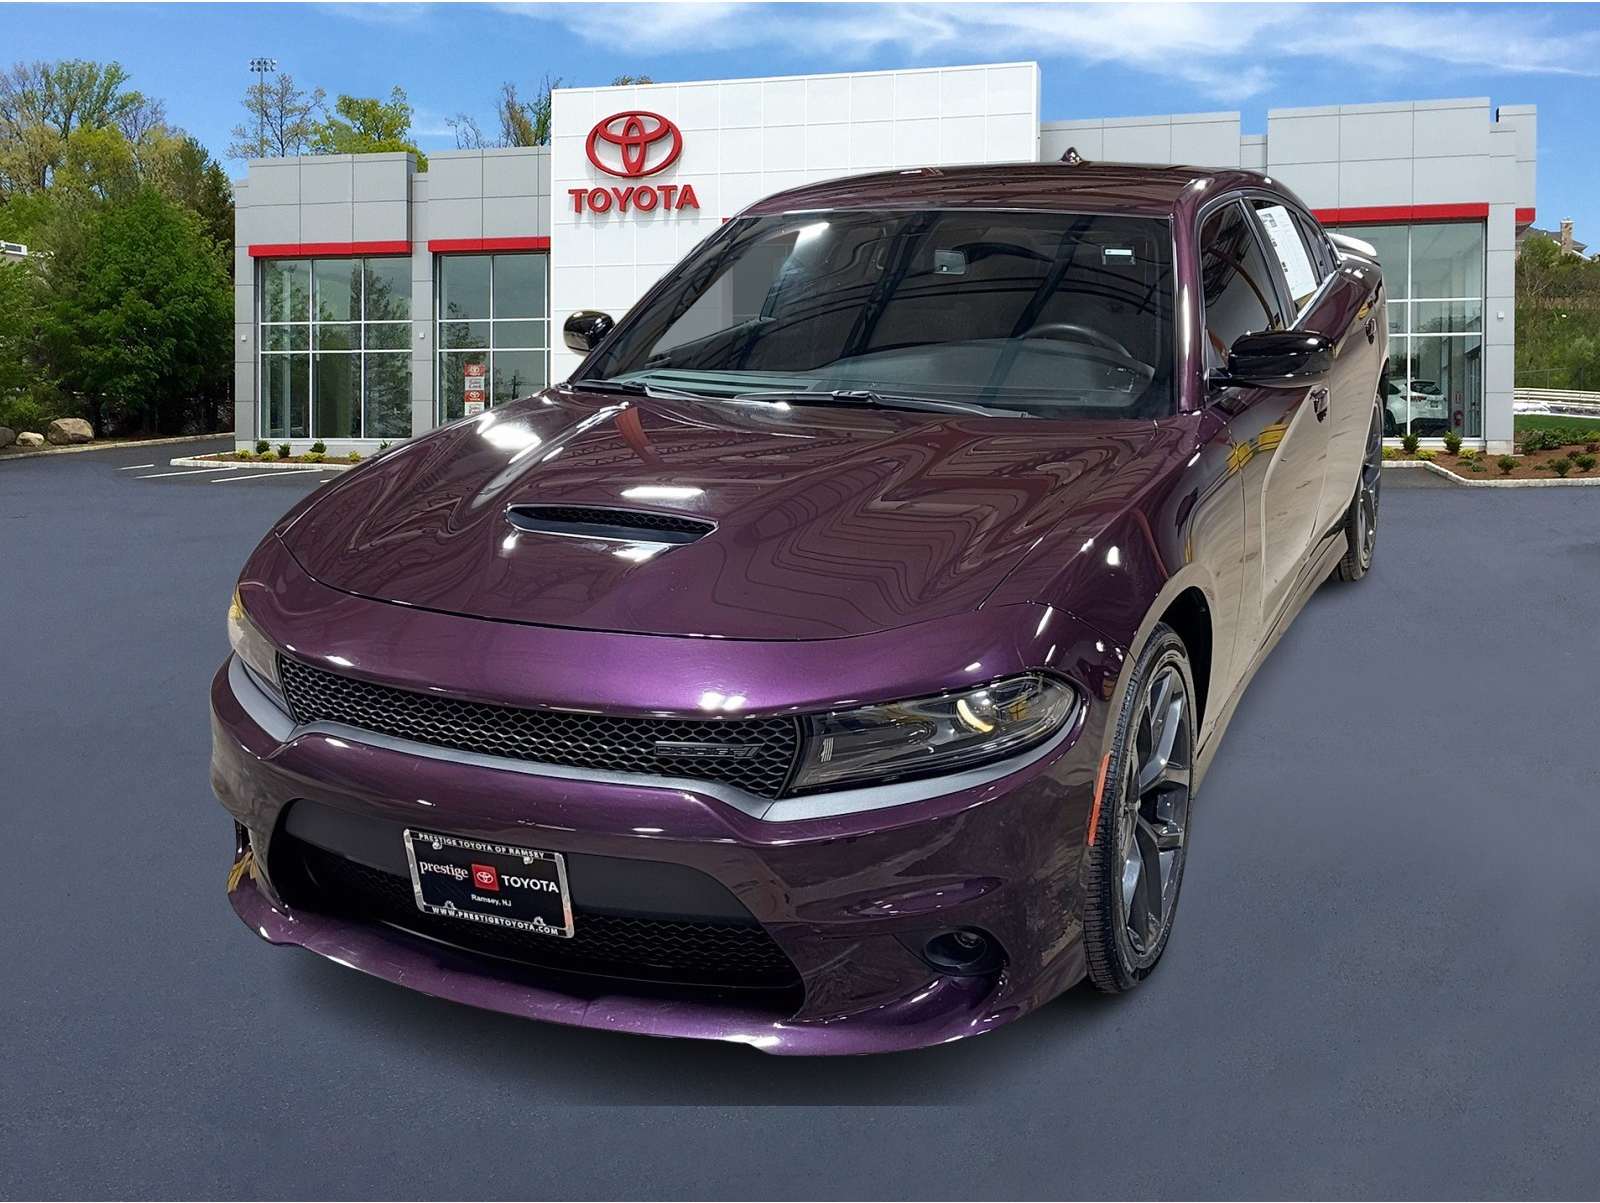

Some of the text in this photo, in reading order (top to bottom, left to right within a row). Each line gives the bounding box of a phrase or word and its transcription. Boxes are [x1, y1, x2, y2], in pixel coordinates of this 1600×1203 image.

[568, 184, 700, 214] TOYOTA
[418, 832, 457, 847] PRESTIGE
[458, 840, 493, 852] TOYOTA
[508, 848, 545, 859] RAMSEY
[419, 861, 559, 893] prestige TOYOTA
[471, 893, 512, 907] Ramsey, NJ
[432, 907, 559, 935] WWW.PRESTIGETOYOTA.COM
